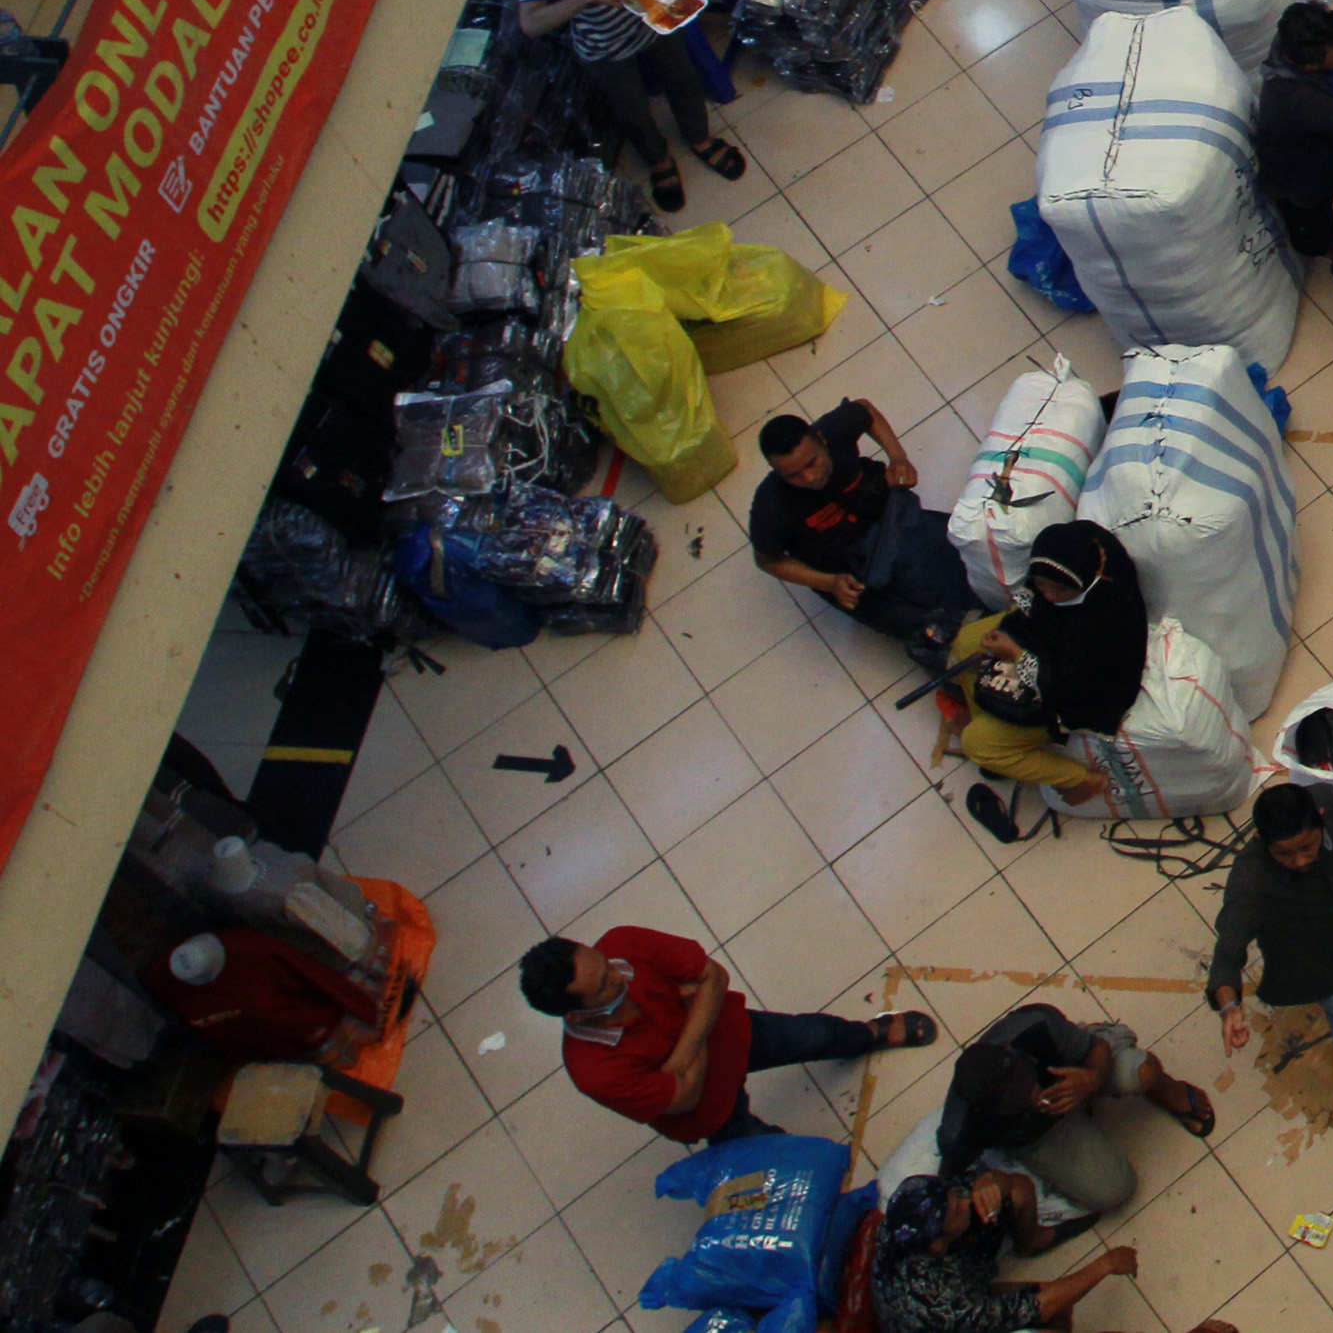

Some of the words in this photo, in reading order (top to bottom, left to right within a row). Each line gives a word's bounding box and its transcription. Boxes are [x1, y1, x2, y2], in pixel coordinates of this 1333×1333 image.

[188, 24, 255, 157] BANTUAN
[0, 129, 88, 342] LAN
[46, 348, 106, 464] GRATIS
[98, 233, 157, 351] ONGKIR
[115, 423, 162, 526] memenuhi
[157, 370, 187, 433] syarat
[180, 337, 200, 376] dan
[194, 251, 239, 342] ketentuan
[235, 212, 258, 259] yang
[251, 148, 286, 217] berlaku
[47, 511, 82, 584] Info
[74, 435, 116, 522] lebih
[107, 358, 154, 449] lanjut
[143, 241, 208, 375] kunjungi:
